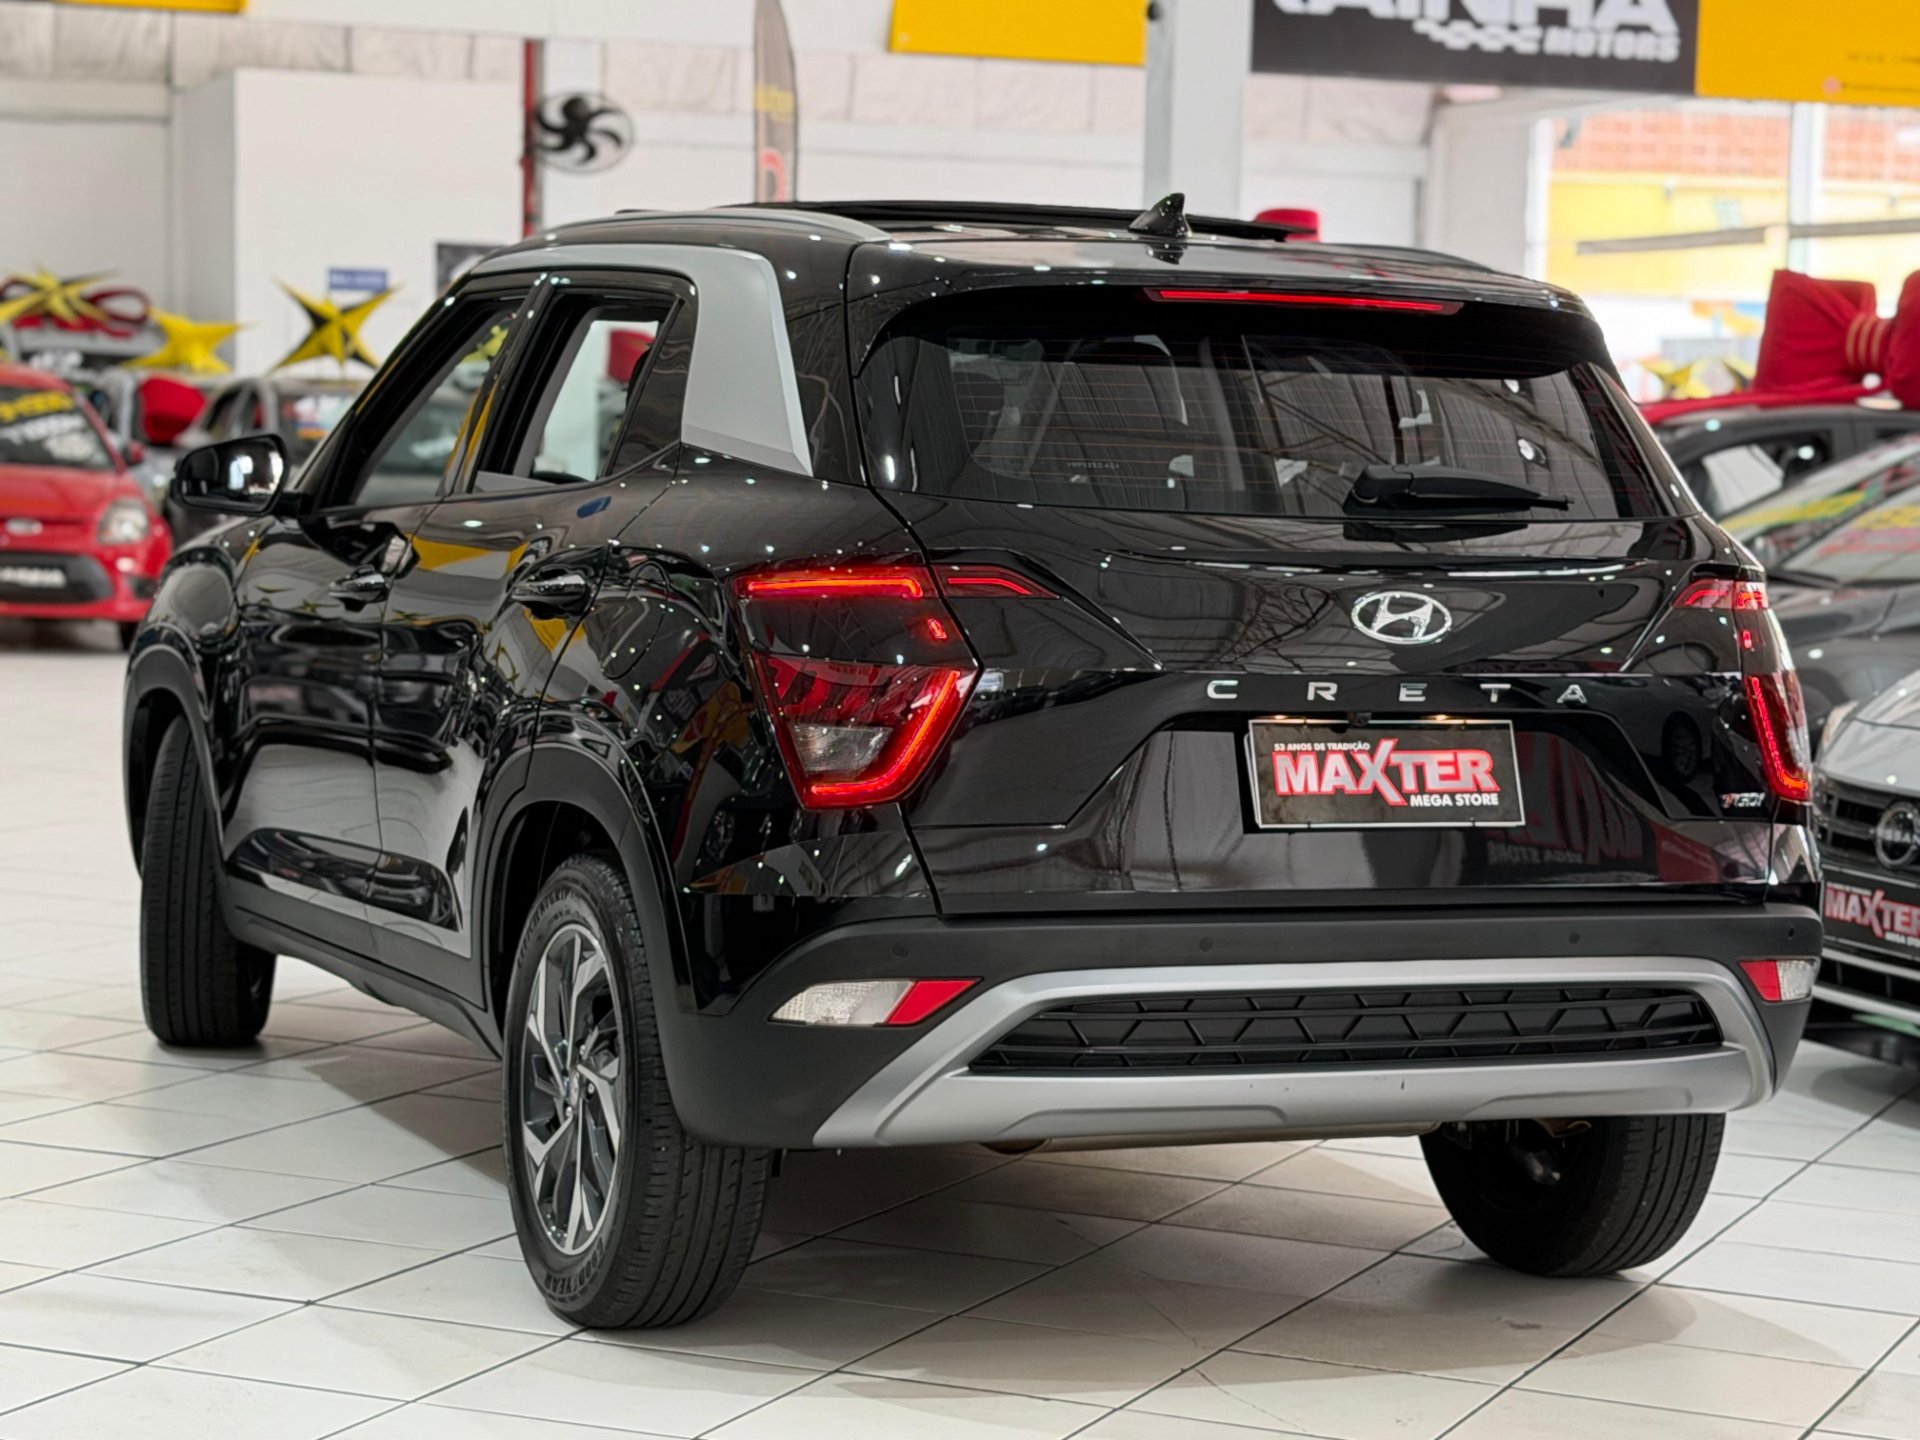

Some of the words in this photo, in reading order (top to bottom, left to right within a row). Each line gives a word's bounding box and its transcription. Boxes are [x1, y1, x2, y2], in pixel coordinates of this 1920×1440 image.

[1544, 29, 1680, 62] MOTORS
[1207, 679, 1588, 704] CRETA
[1287, 742, 1313, 751] ANOS
[1314, 742, 1326, 751] DE
[1327, 740, 1371, 753] TRADIÇÃO
[1272, 738, 1500, 806] MAXTER
[1410, 793, 1453, 807] MEGA
[1455, 793, 1499, 806] STORE
